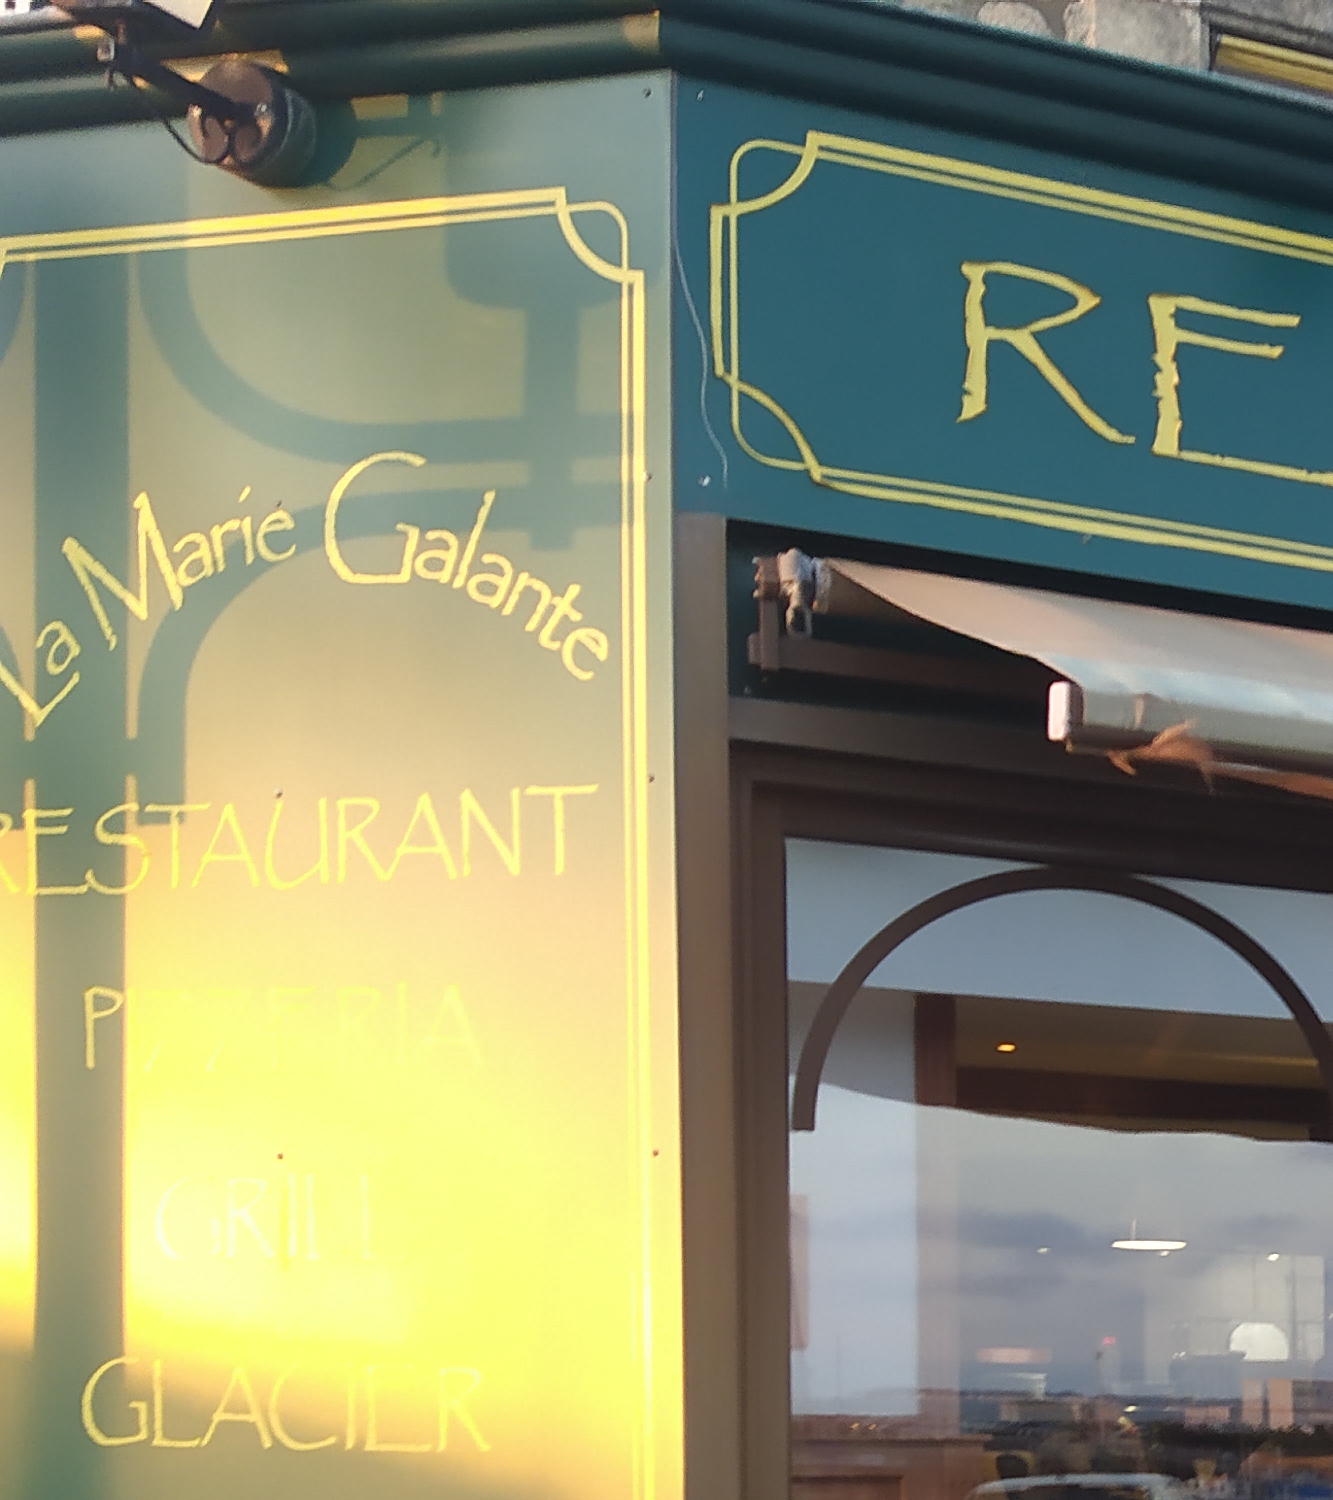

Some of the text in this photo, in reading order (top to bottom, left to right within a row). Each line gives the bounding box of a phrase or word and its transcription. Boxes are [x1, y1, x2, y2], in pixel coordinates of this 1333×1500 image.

[0, 619, 81, 728] La
[323, 450, 609, 682] Galante
[81, 1356, 491, 1453] GLACIER
